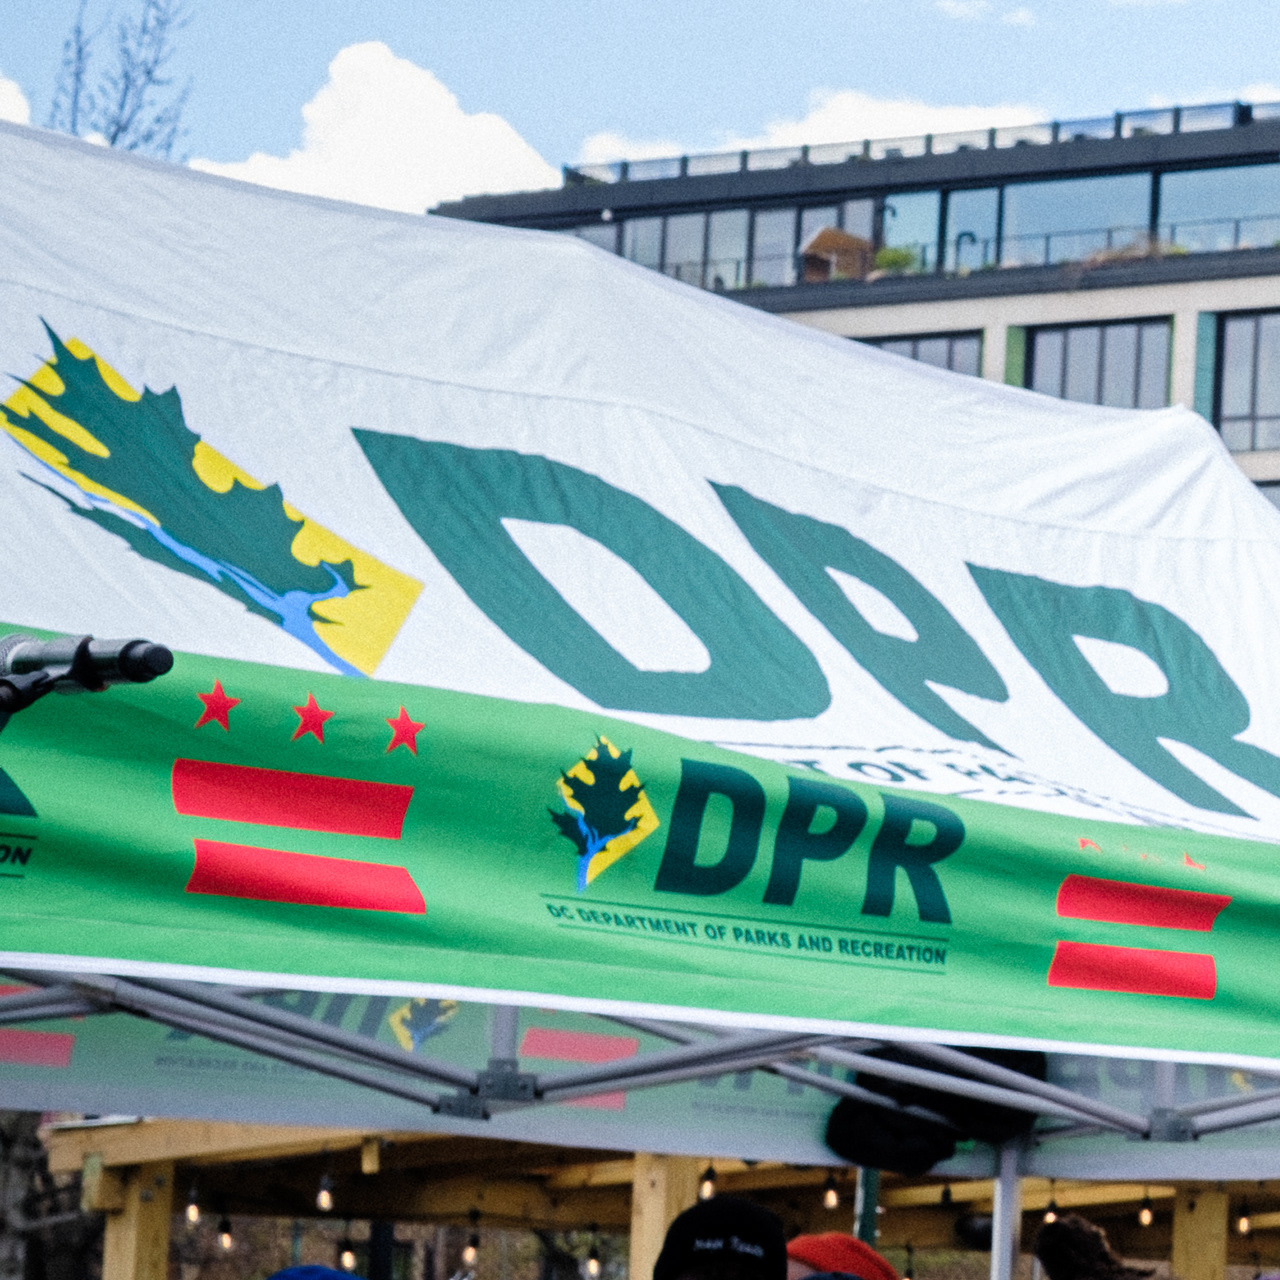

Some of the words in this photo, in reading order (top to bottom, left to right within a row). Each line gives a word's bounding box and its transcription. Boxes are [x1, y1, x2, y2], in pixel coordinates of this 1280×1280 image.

[654, 757, 966, 925] DPR
[546, 903, 573, 920] DC
[576, 907, 698, 938] DEPARTMENT
[704, 923, 726, 941] OF
[732, 926, 792, 948] PARKS
[797, 933, 834, 953] AND
[838, 936, 947, 965] RECREATION
